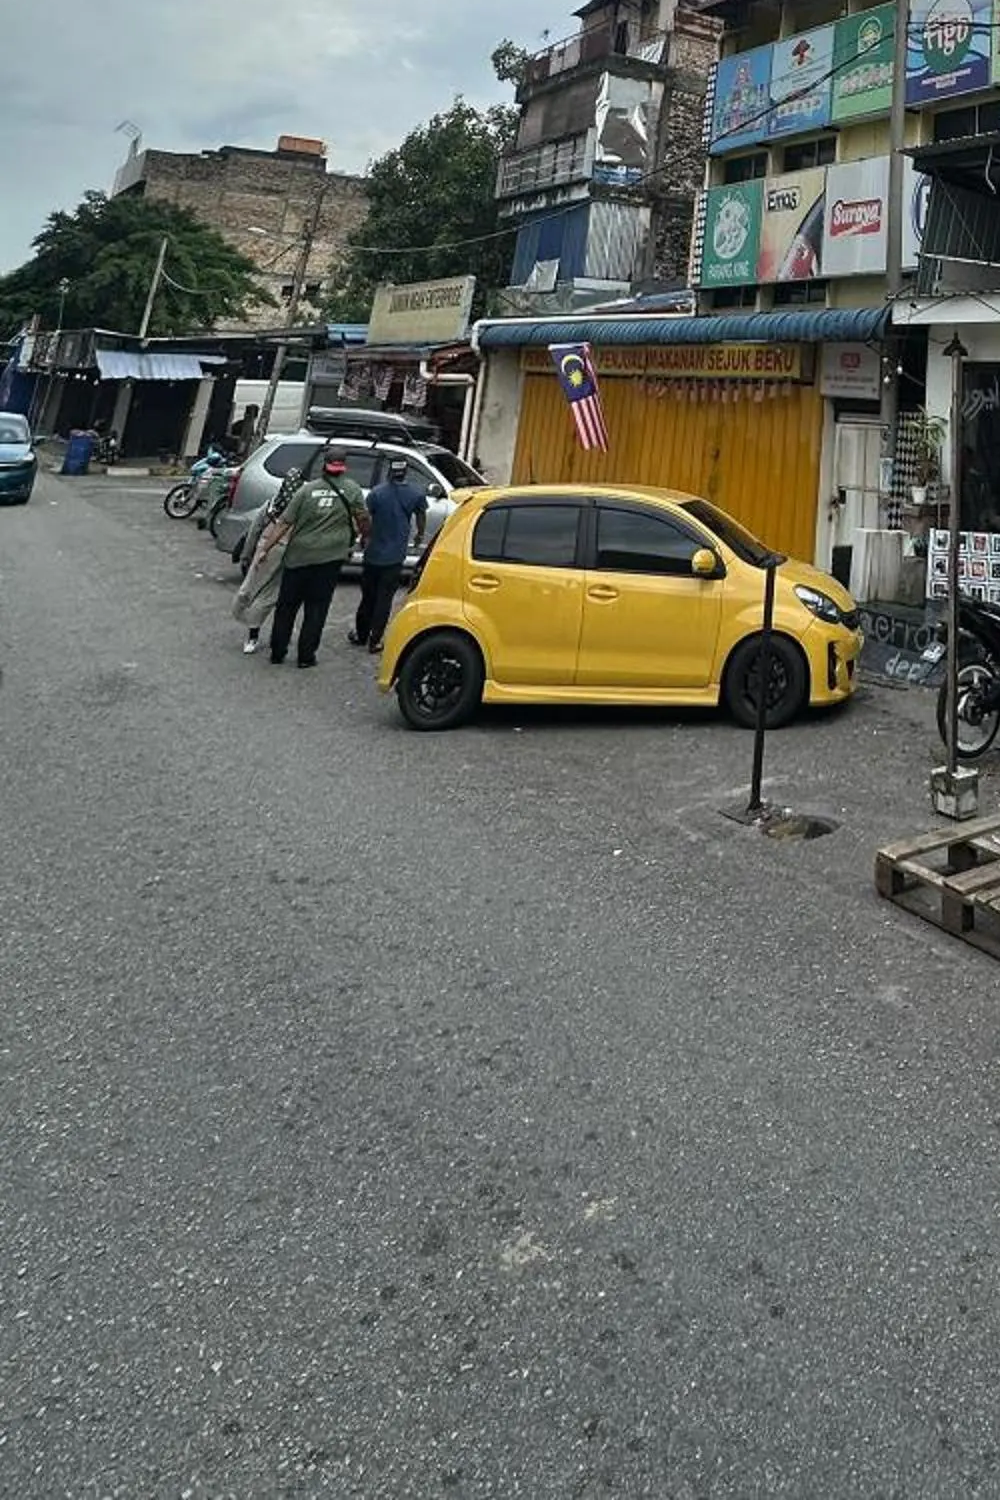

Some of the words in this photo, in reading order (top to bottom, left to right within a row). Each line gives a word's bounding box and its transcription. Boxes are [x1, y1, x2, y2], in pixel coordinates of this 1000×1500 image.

[651, 348, 703, 372] MAKANAN
[706, 349, 752, 372] SEJUK
[755, 348, 794, 373] BEKU
